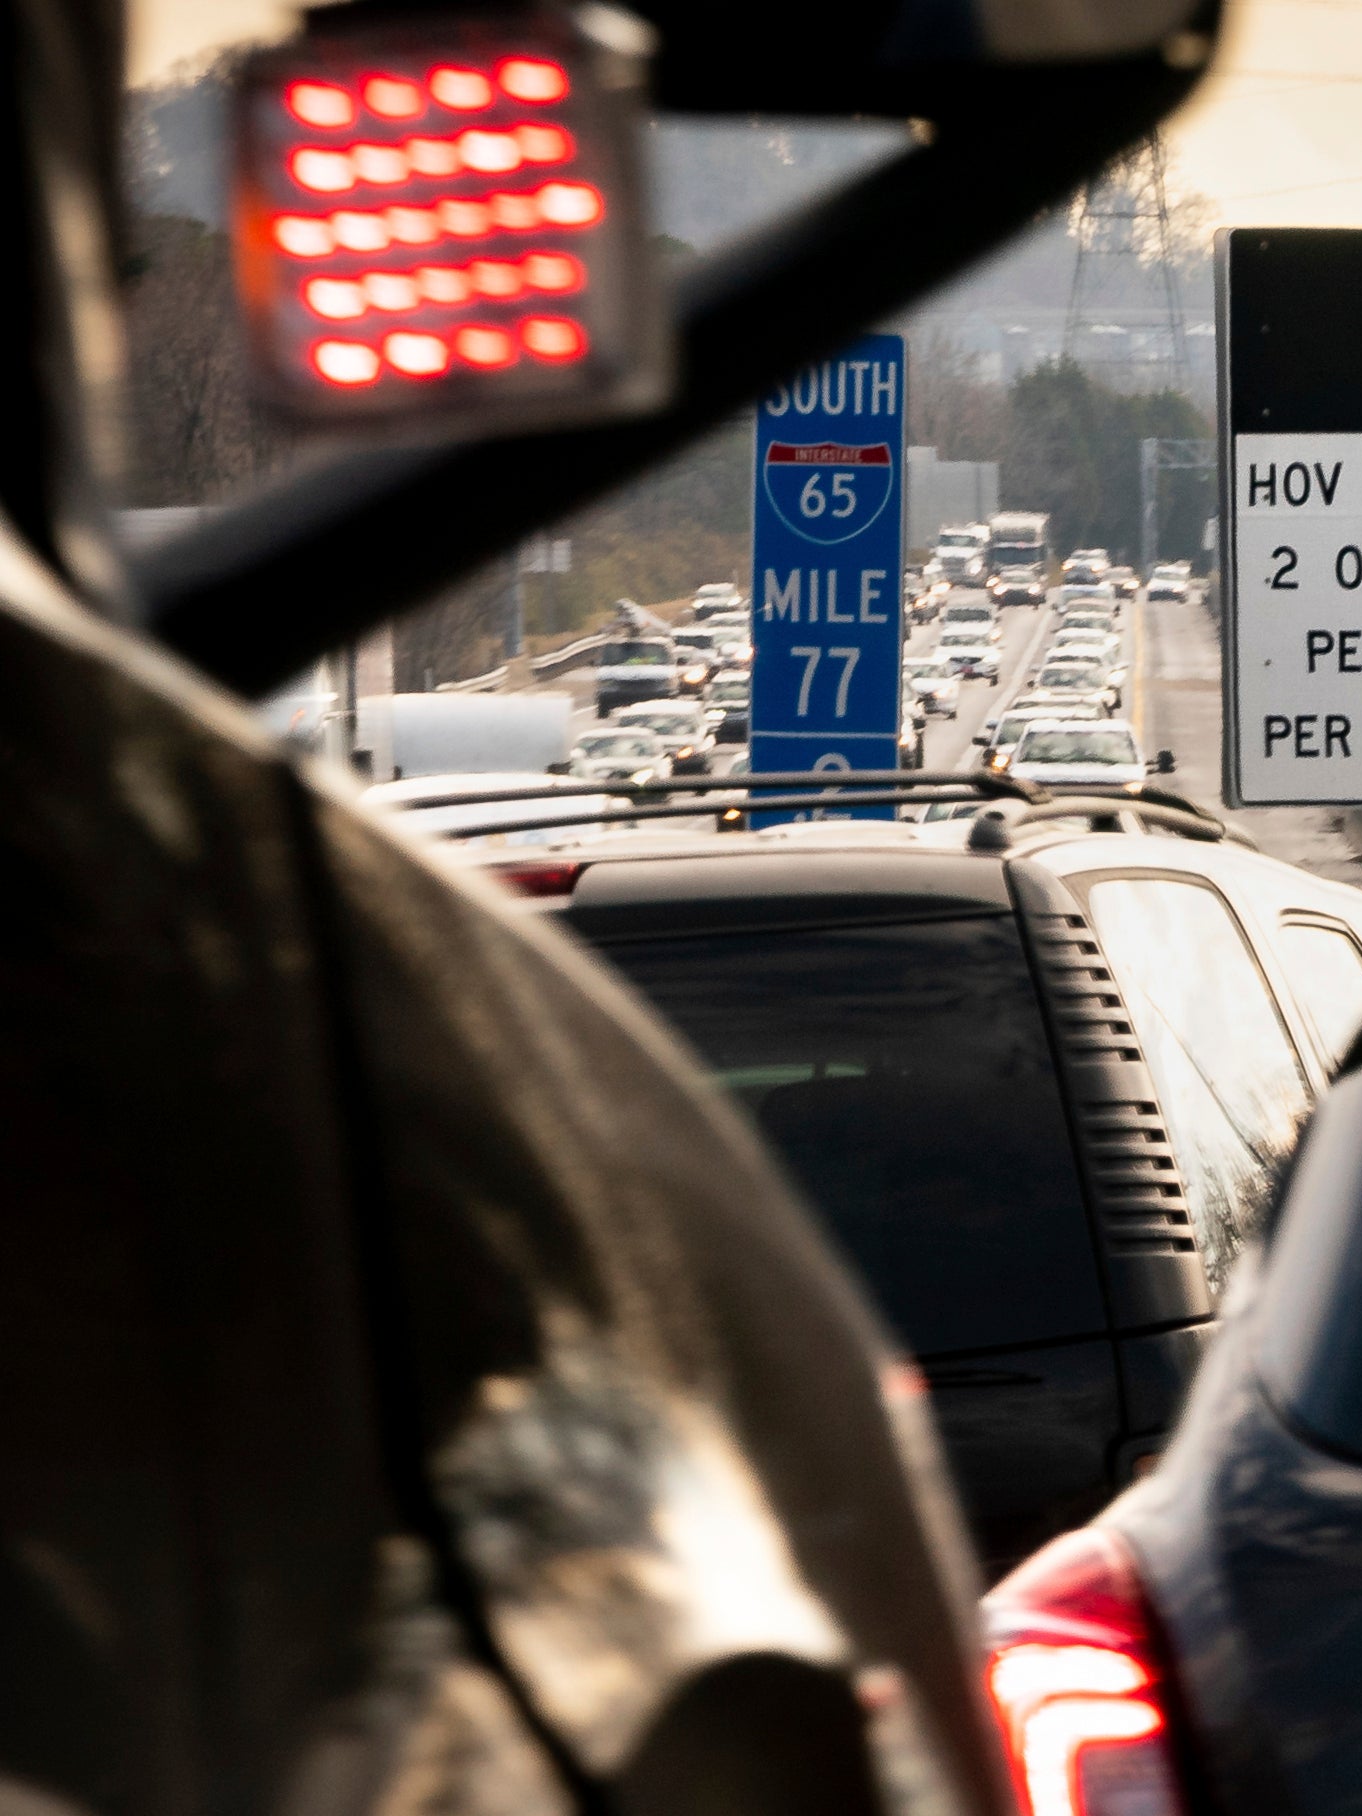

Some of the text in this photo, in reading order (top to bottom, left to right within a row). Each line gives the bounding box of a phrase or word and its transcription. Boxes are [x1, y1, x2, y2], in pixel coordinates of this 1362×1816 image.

[795, 448, 863, 463] INTERSTATE
[801, 472, 856, 518] 65
[1249, 462, 1342, 506] HOV
[1271, 546, 1299, 590] 2
[763, 569, 887, 624] MILE
[791, 647, 860, 718] 77
[1264, 715, 1351, 758] PER
